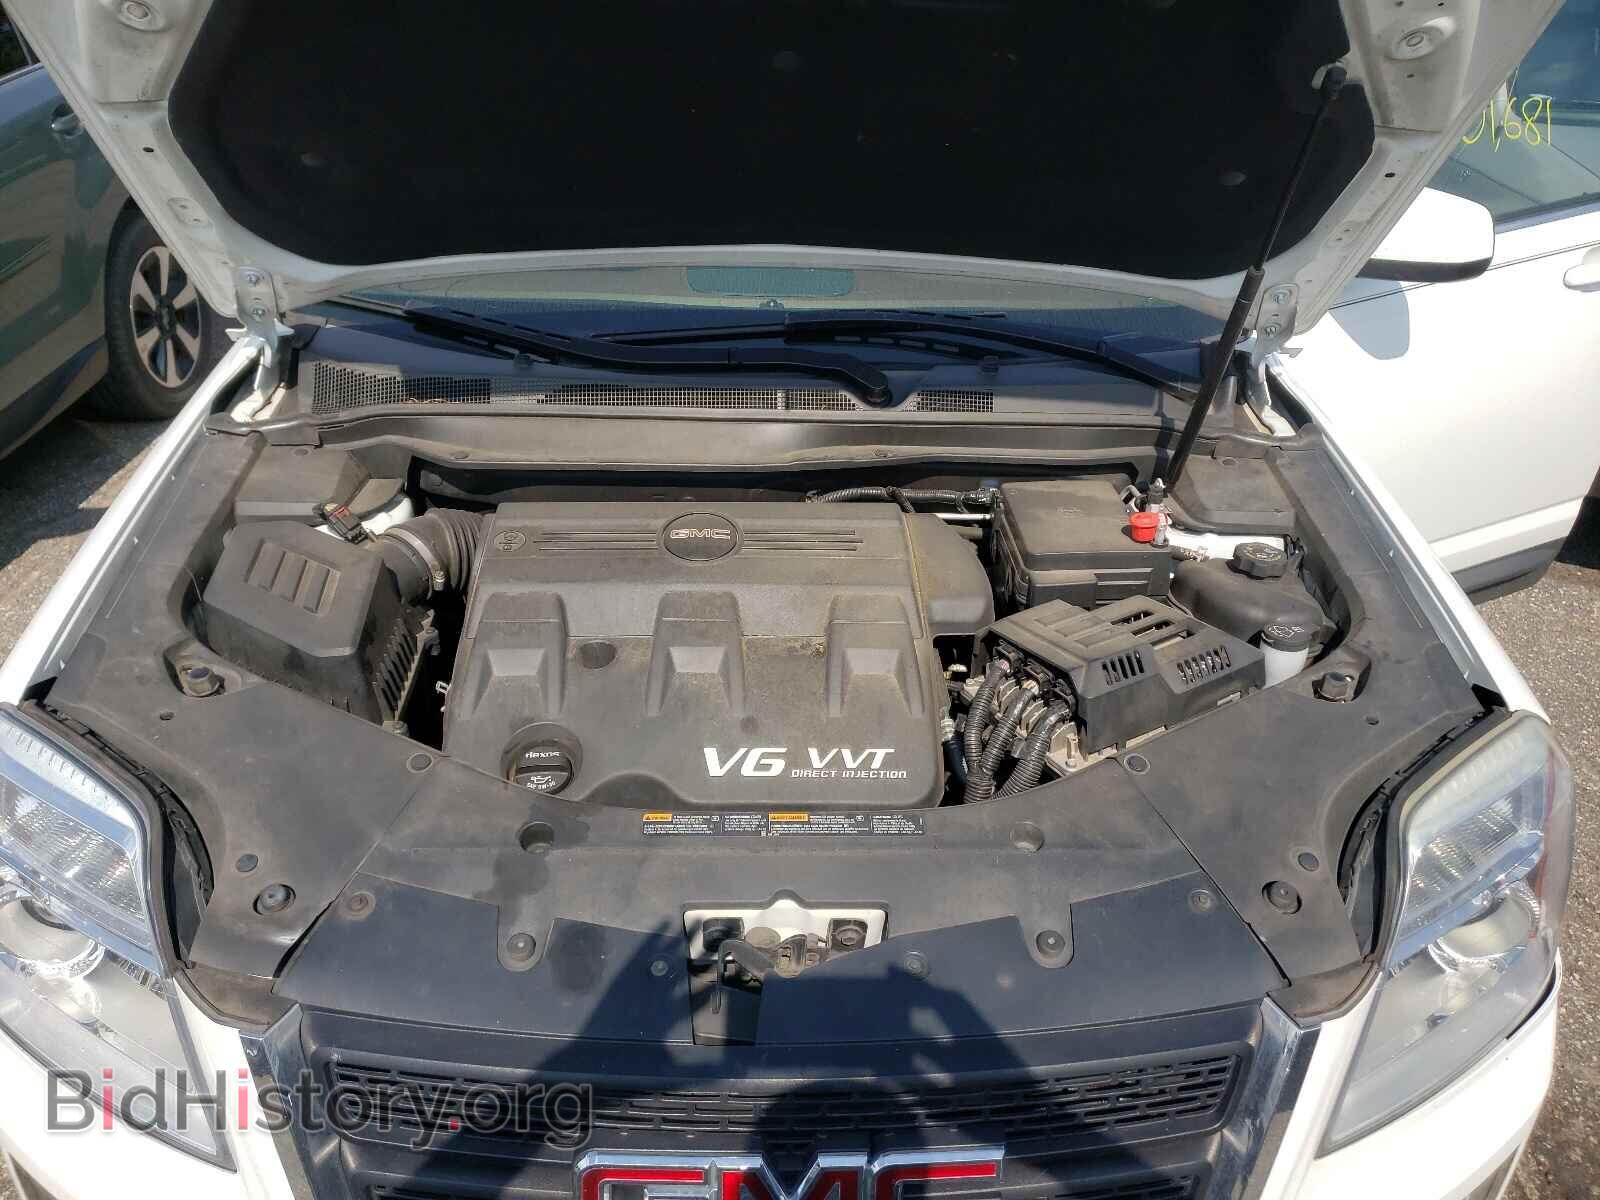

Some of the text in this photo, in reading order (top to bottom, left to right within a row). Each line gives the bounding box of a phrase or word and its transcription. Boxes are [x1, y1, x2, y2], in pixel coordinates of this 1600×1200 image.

[670, 529, 731, 539] GMC
[703, 747, 896, 776] V6 VVT
[791, 769, 838, 779] DIRECT
